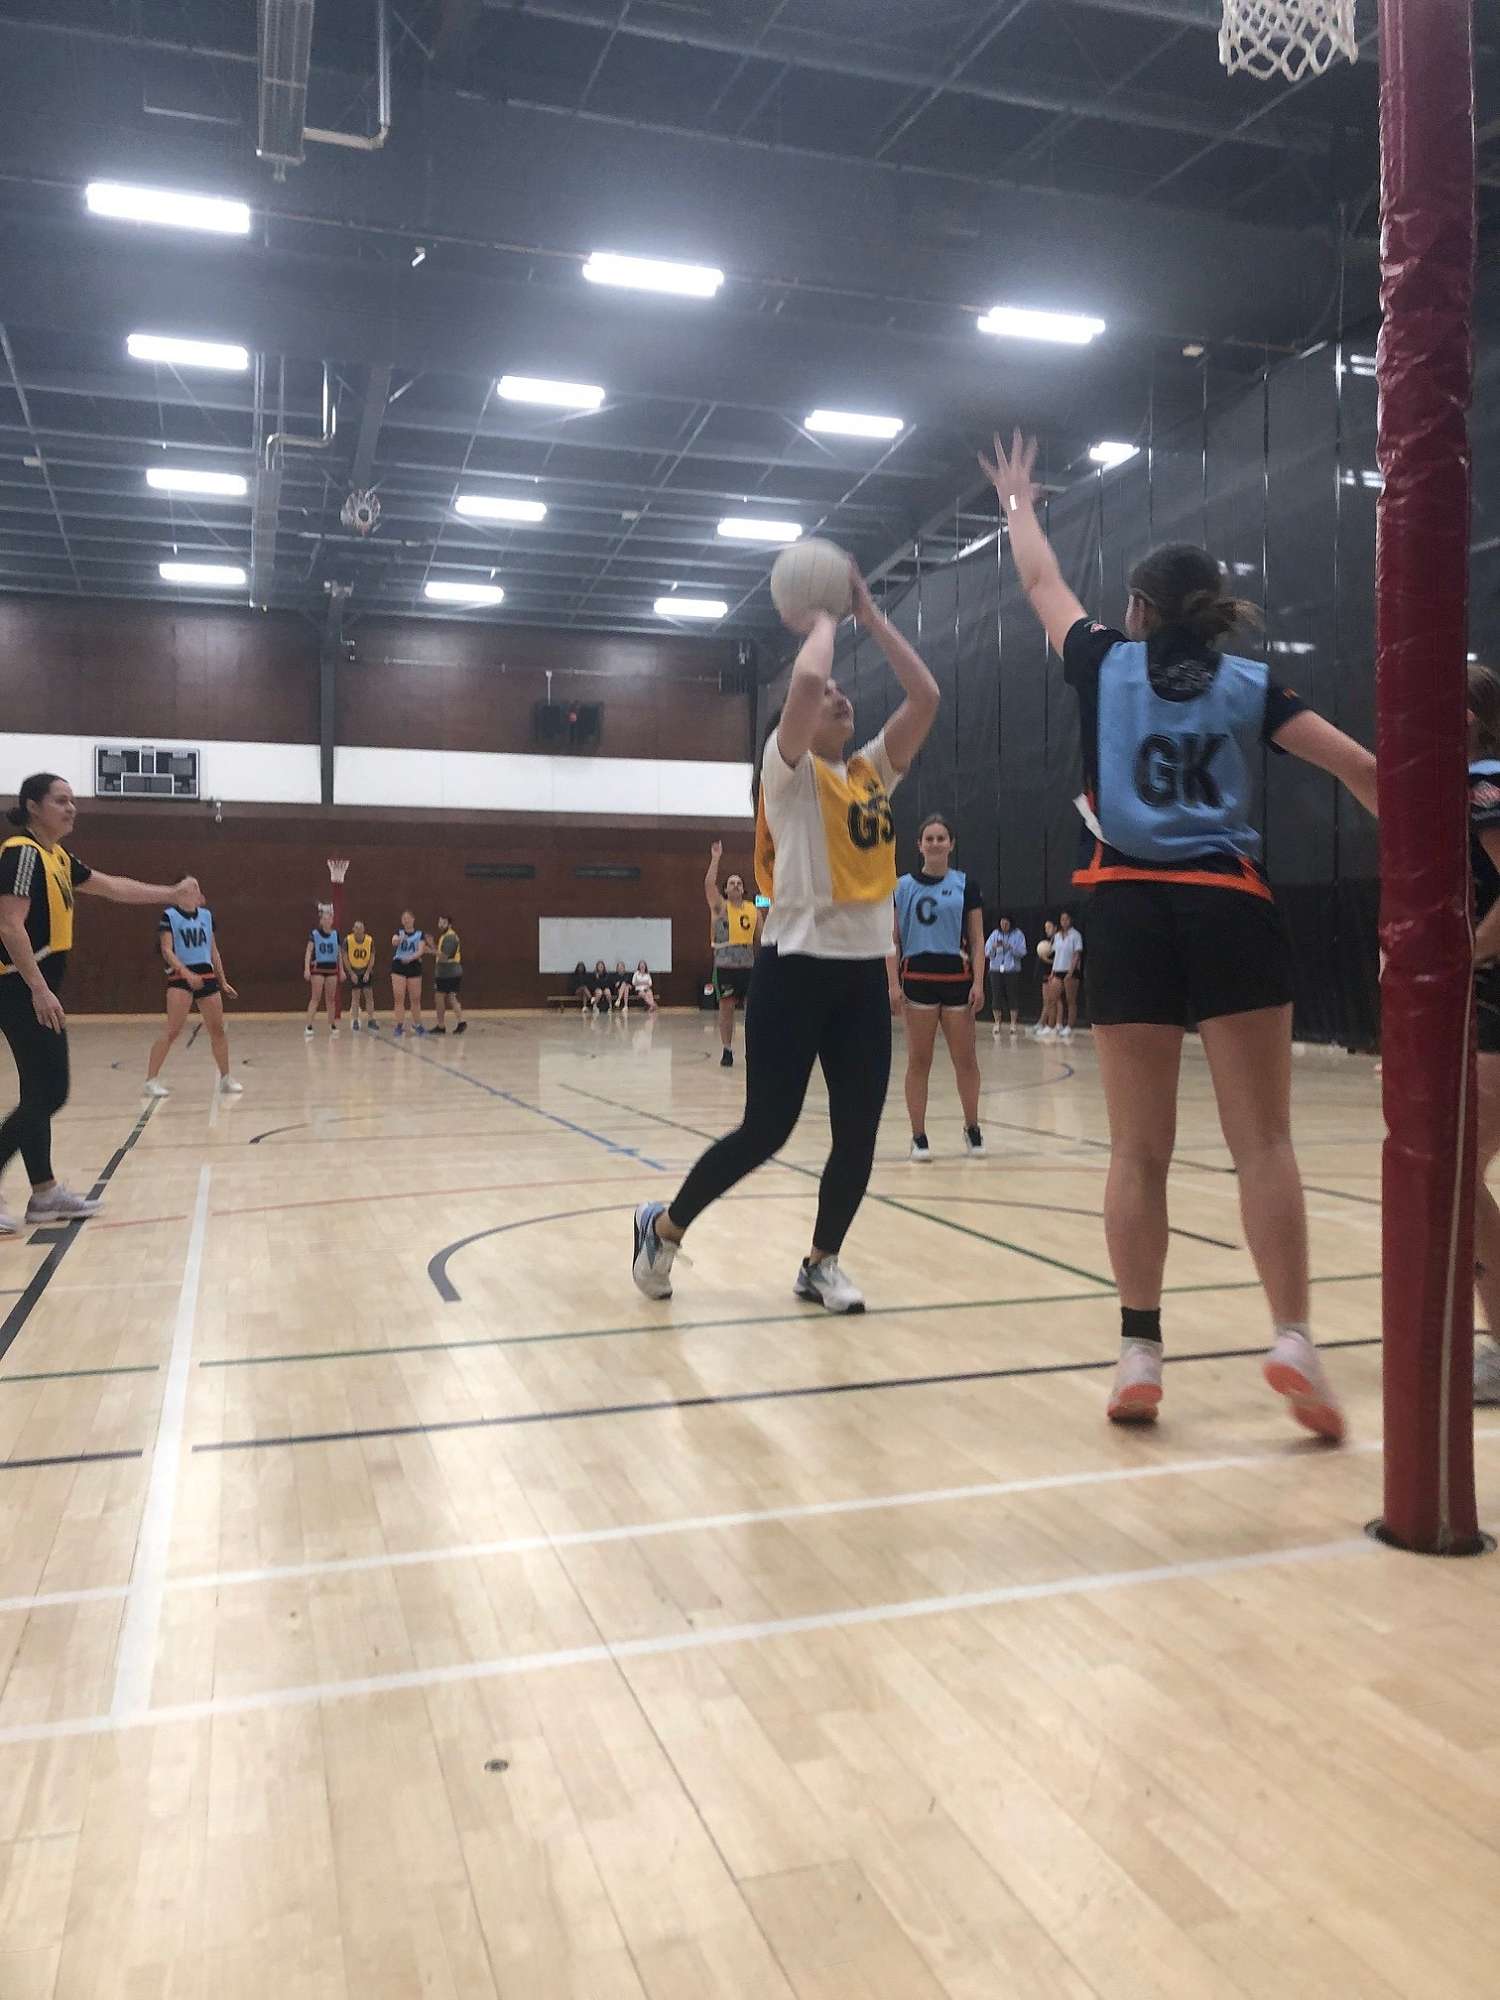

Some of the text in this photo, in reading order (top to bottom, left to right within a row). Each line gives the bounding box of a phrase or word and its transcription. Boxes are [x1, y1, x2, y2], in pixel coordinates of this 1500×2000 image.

[1134, 732, 1229, 809] GK
[740, 914, 751, 930] C
[915, 896, 938, 927] C
[179, 927, 207, 948] WA
